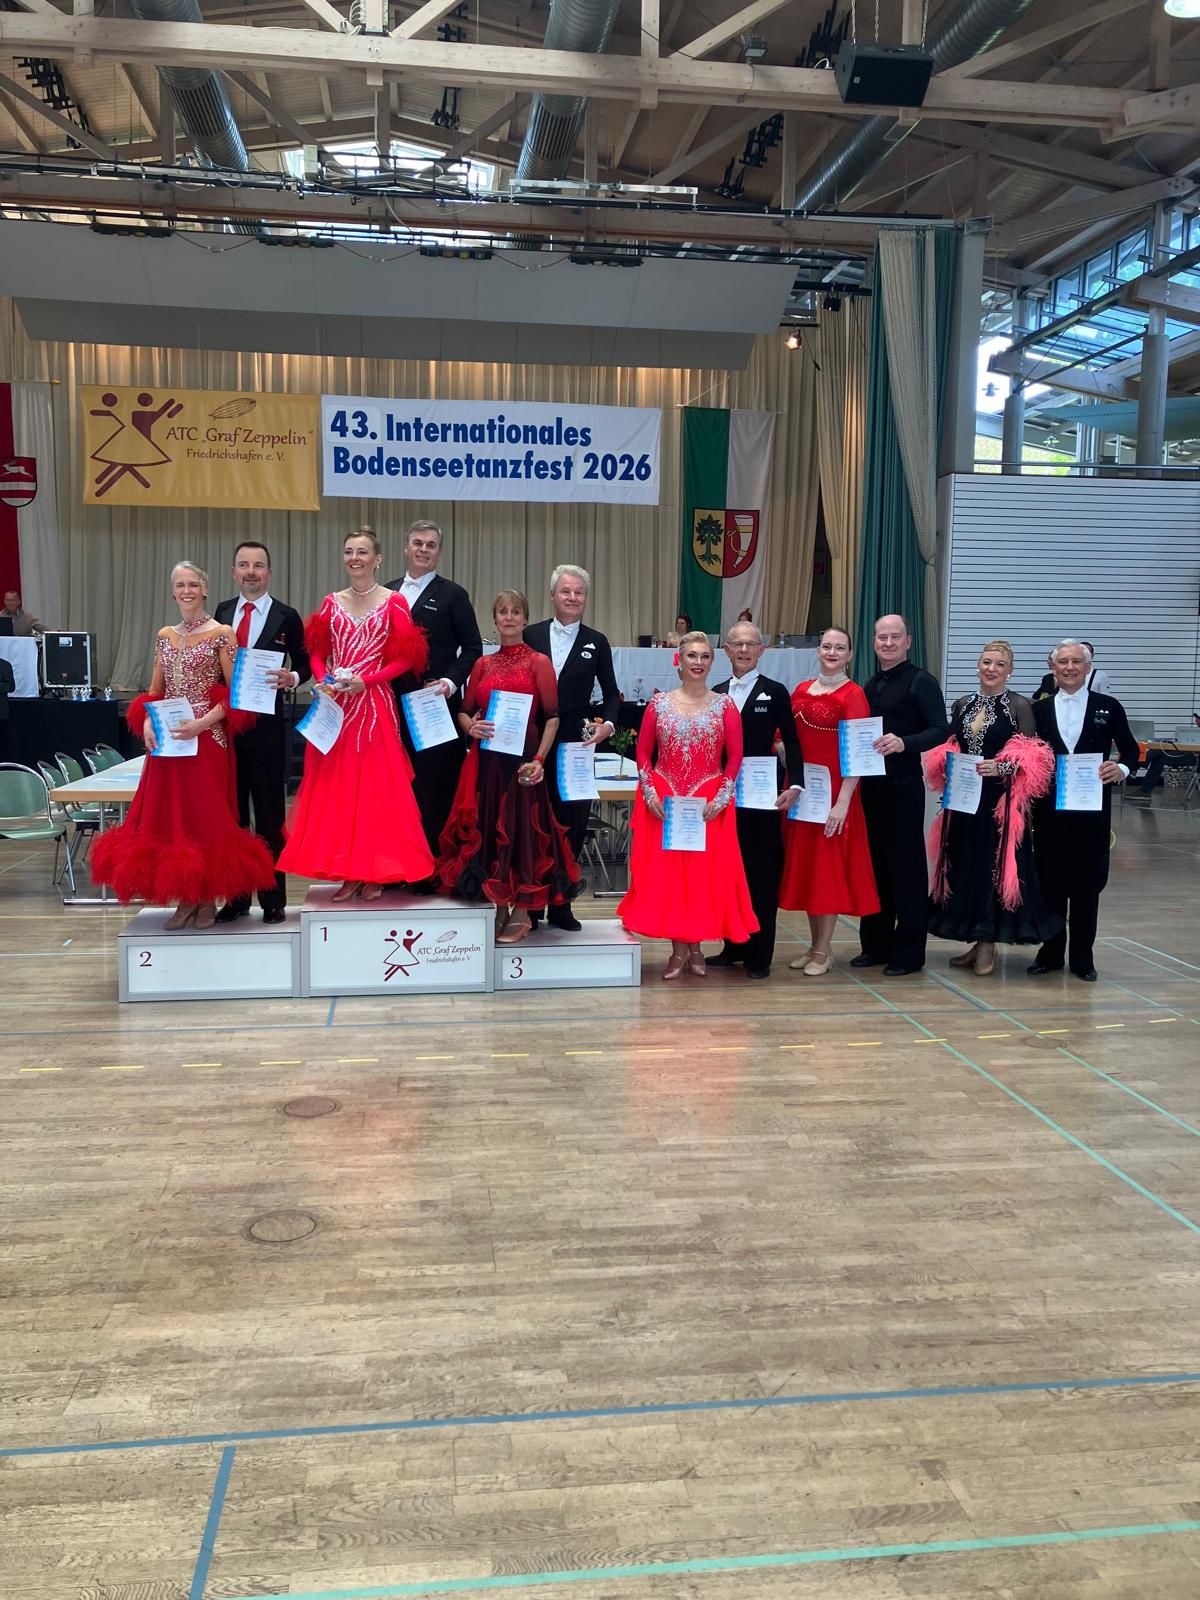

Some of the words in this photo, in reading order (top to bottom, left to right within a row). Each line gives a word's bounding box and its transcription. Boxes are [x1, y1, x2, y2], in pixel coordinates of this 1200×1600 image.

[166, 426, 198, 441] ATC
[330, 410, 378, 440] 43.
[386, 414, 592, 447] Internationales
[186, 448, 263, 463] Friedrichshafen
[276, 451, 286, 461] V.
[333, 446, 573, 481] Bodenseetanzfest
[583, 452, 652, 482] 2026
[319, 926, 328, 942] 1
[139, 951, 152, 967] 2
[417, 947, 432, 955] ATC
[510, 956, 523, 979] 3
